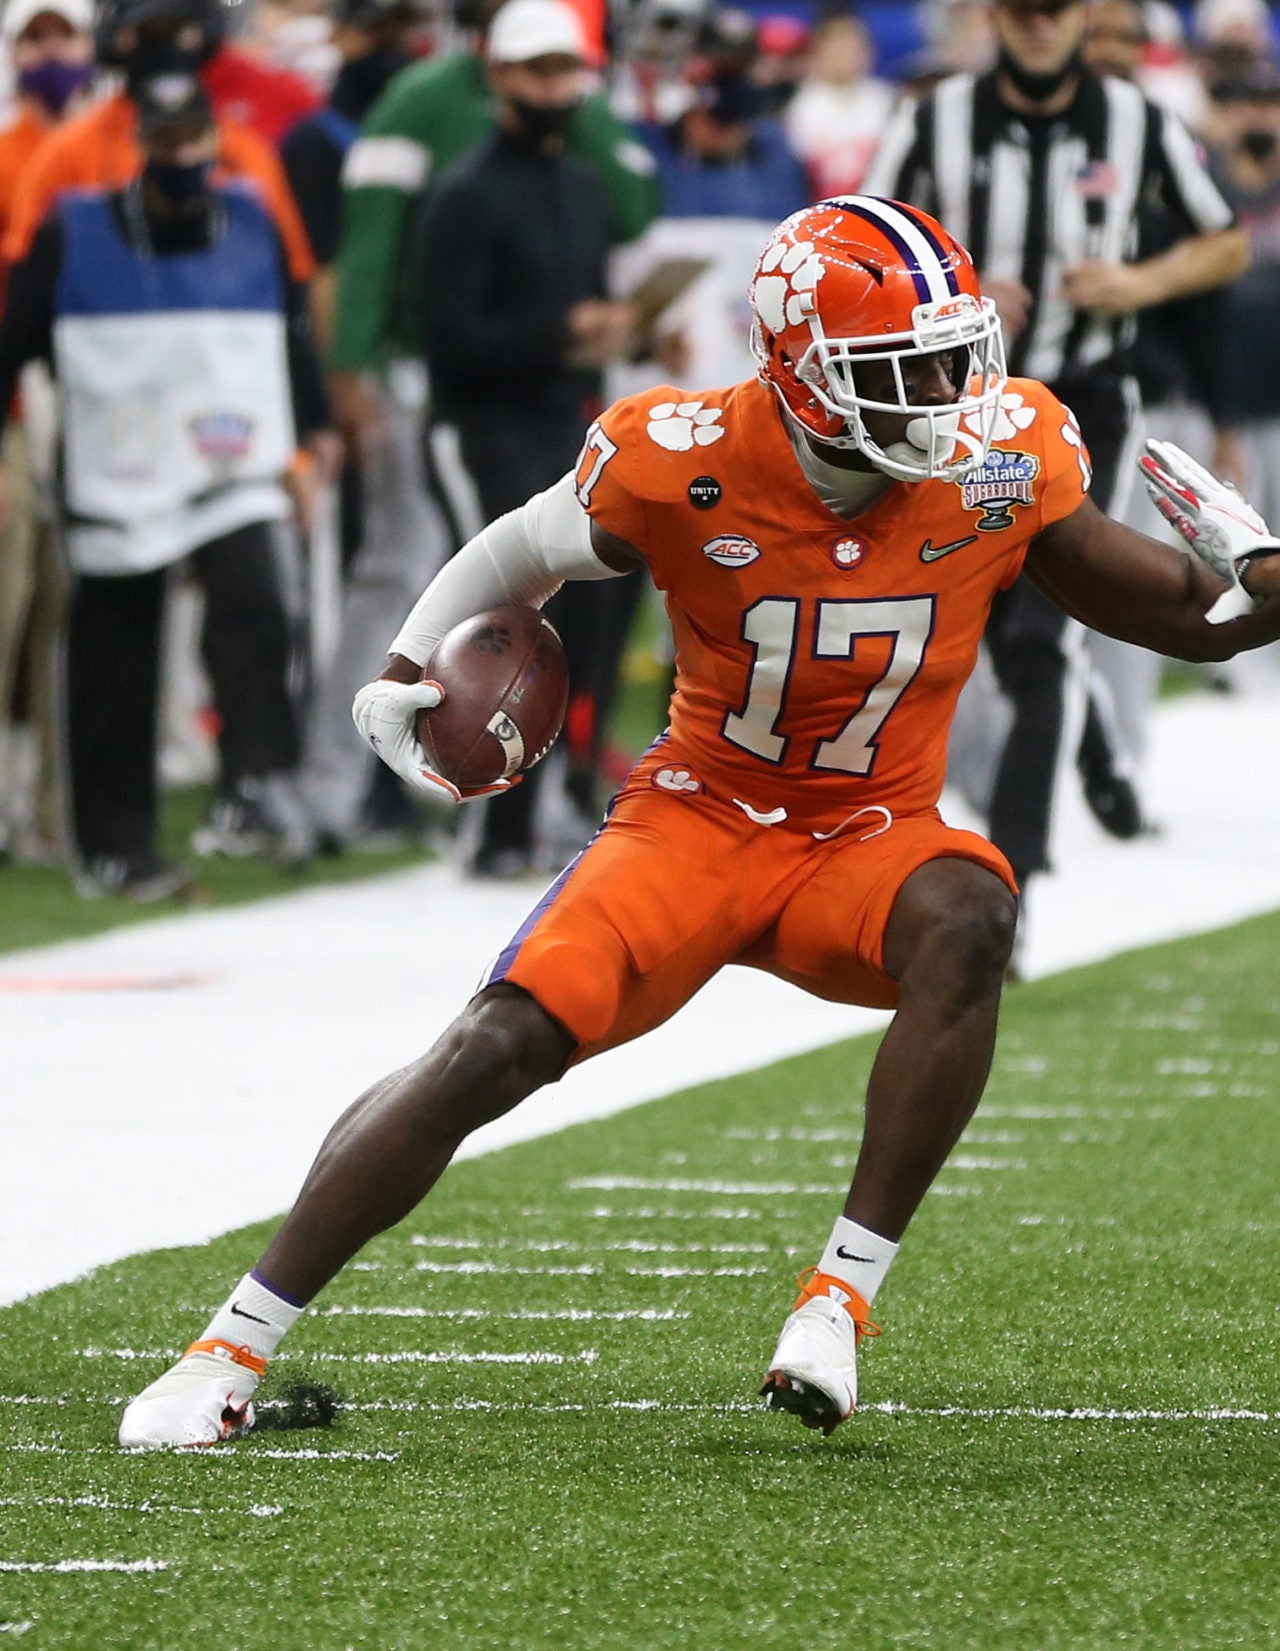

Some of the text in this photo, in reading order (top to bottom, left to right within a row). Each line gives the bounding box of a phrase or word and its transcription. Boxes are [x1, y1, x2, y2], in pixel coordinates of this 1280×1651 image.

[965, 466, 1025, 483] Allstate
[690, 487, 719, 495] UNITY
[712, 543, 752, 556] ACC
[721, 593, 937, 778] 17
